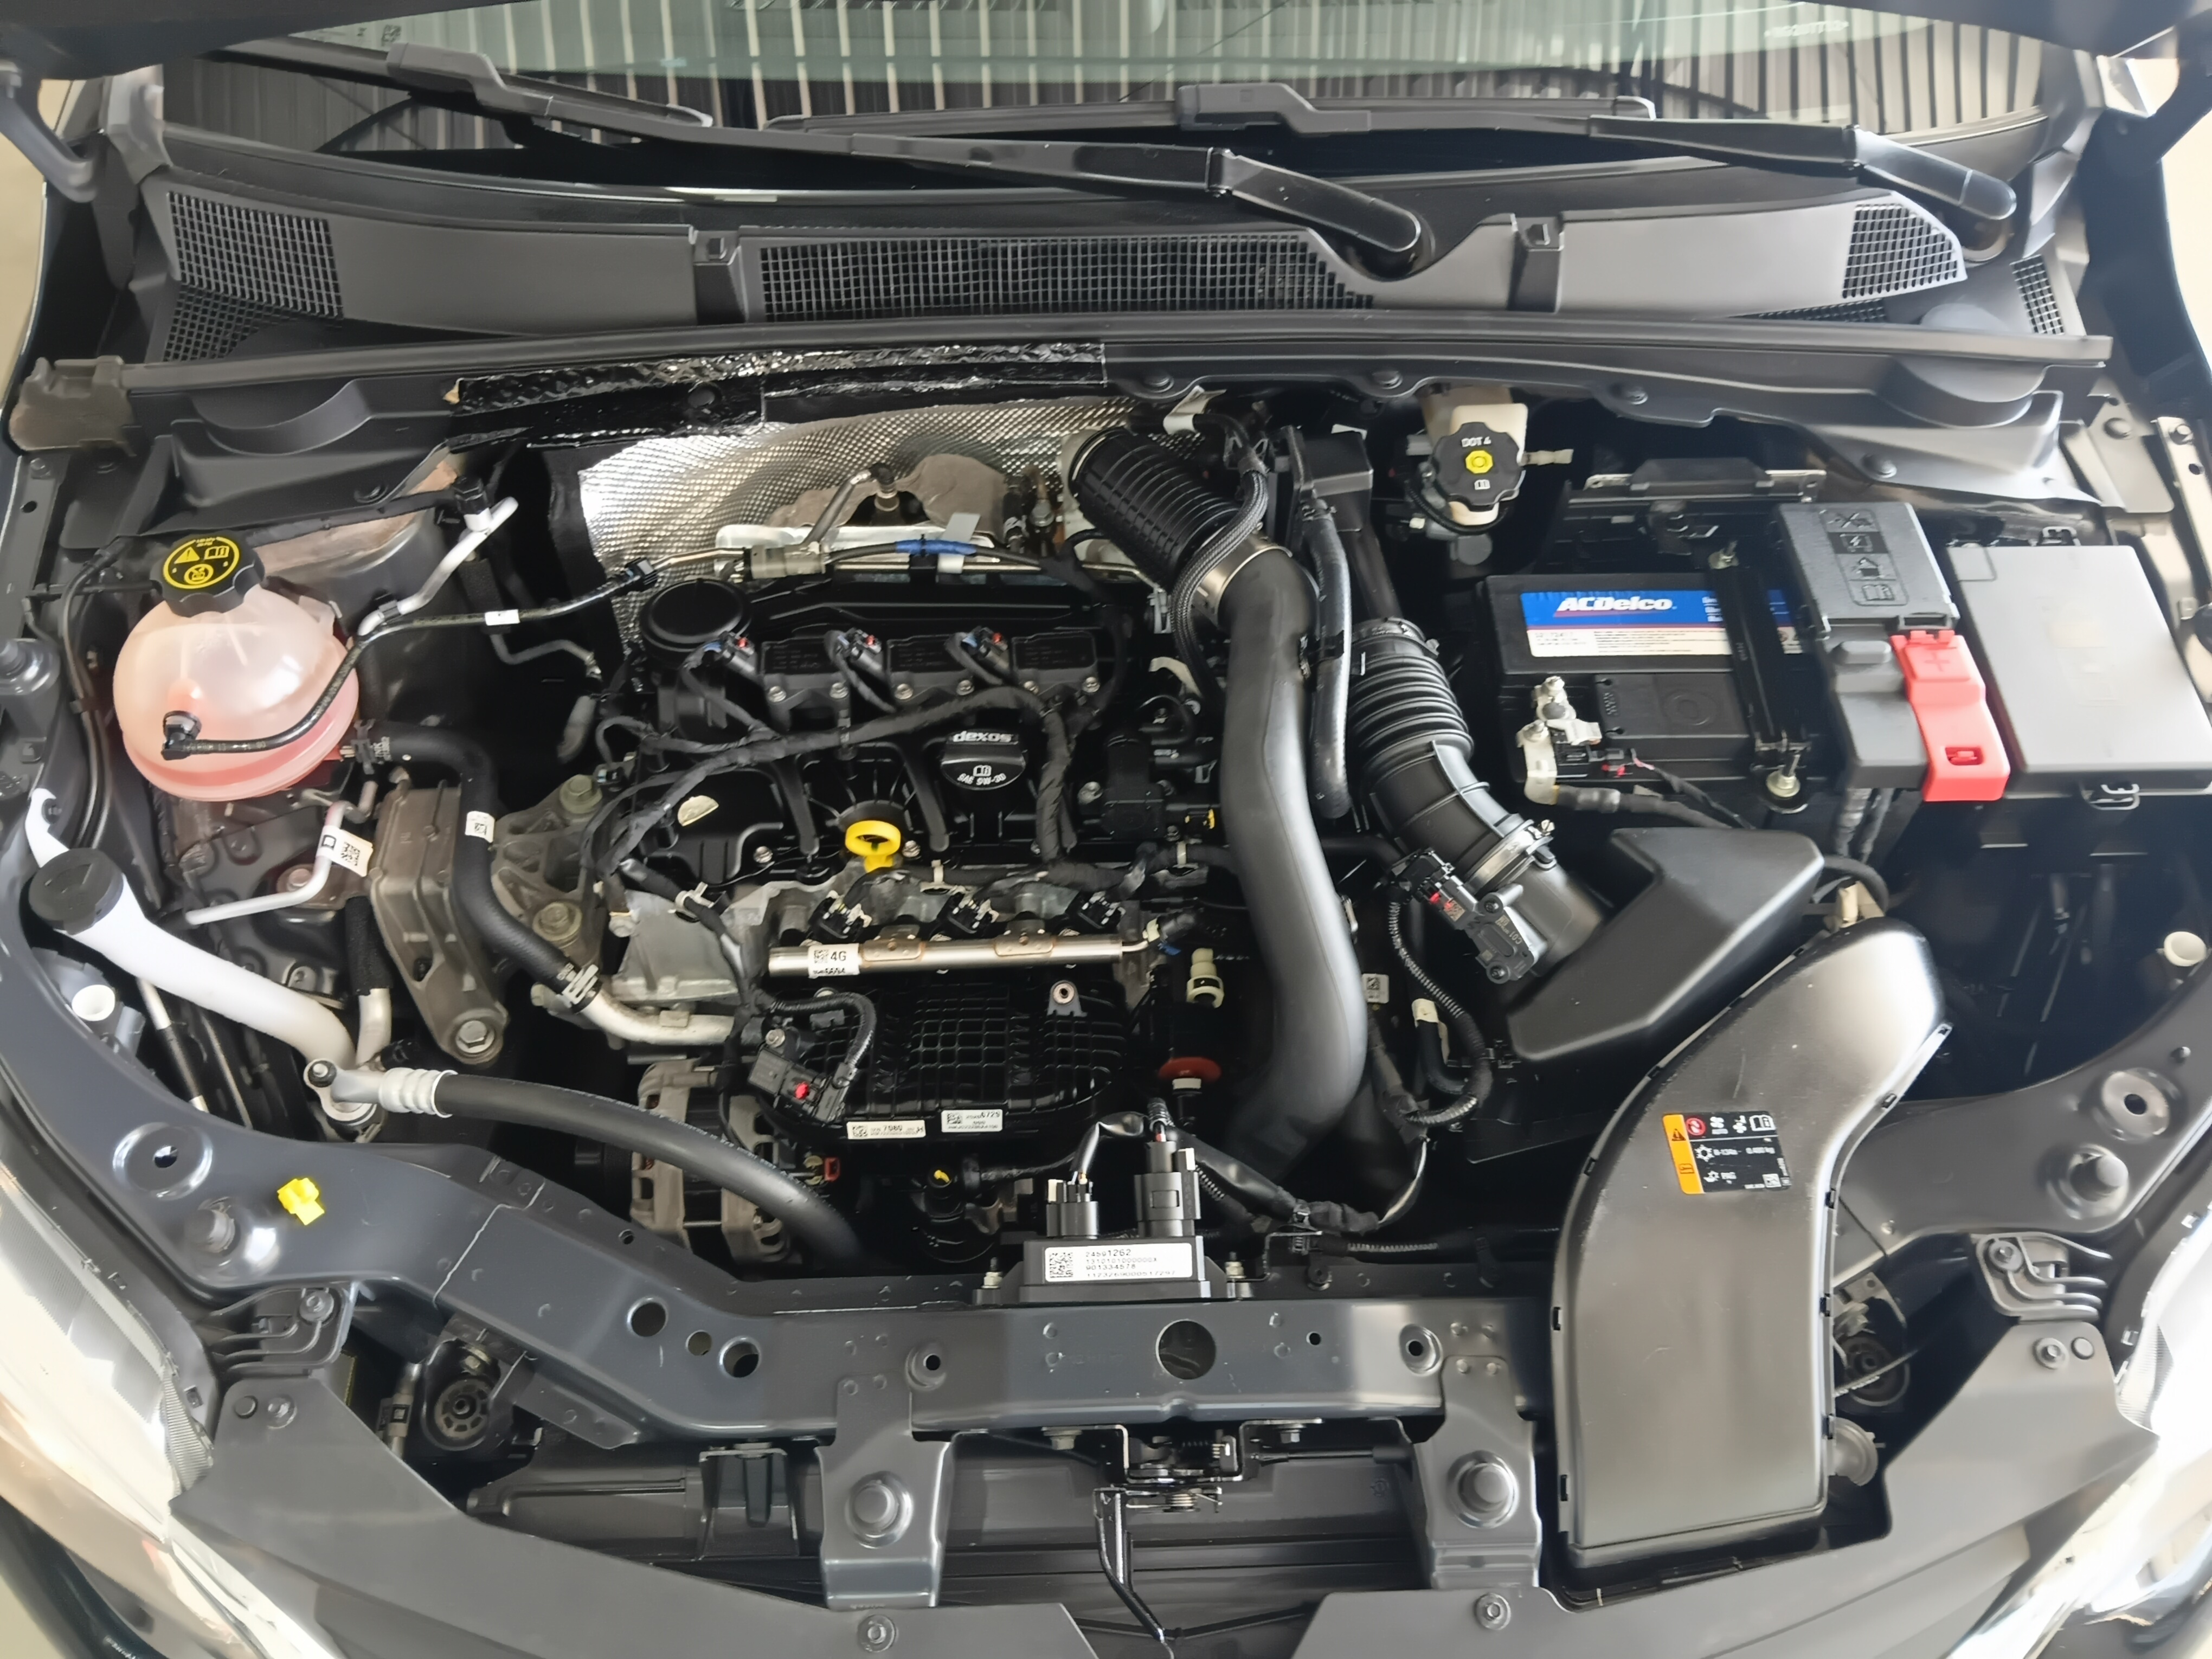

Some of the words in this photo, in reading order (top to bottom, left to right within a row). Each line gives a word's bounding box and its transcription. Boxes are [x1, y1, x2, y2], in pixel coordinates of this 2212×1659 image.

[1462, 437, 1483, 447] DOT
[1557, 596, 1673, 612] ACDelco
[953, 731, 1013, 743] dexos
[957, 773, 975, 785] SAE
[830, 950, 847, 961] 4G
